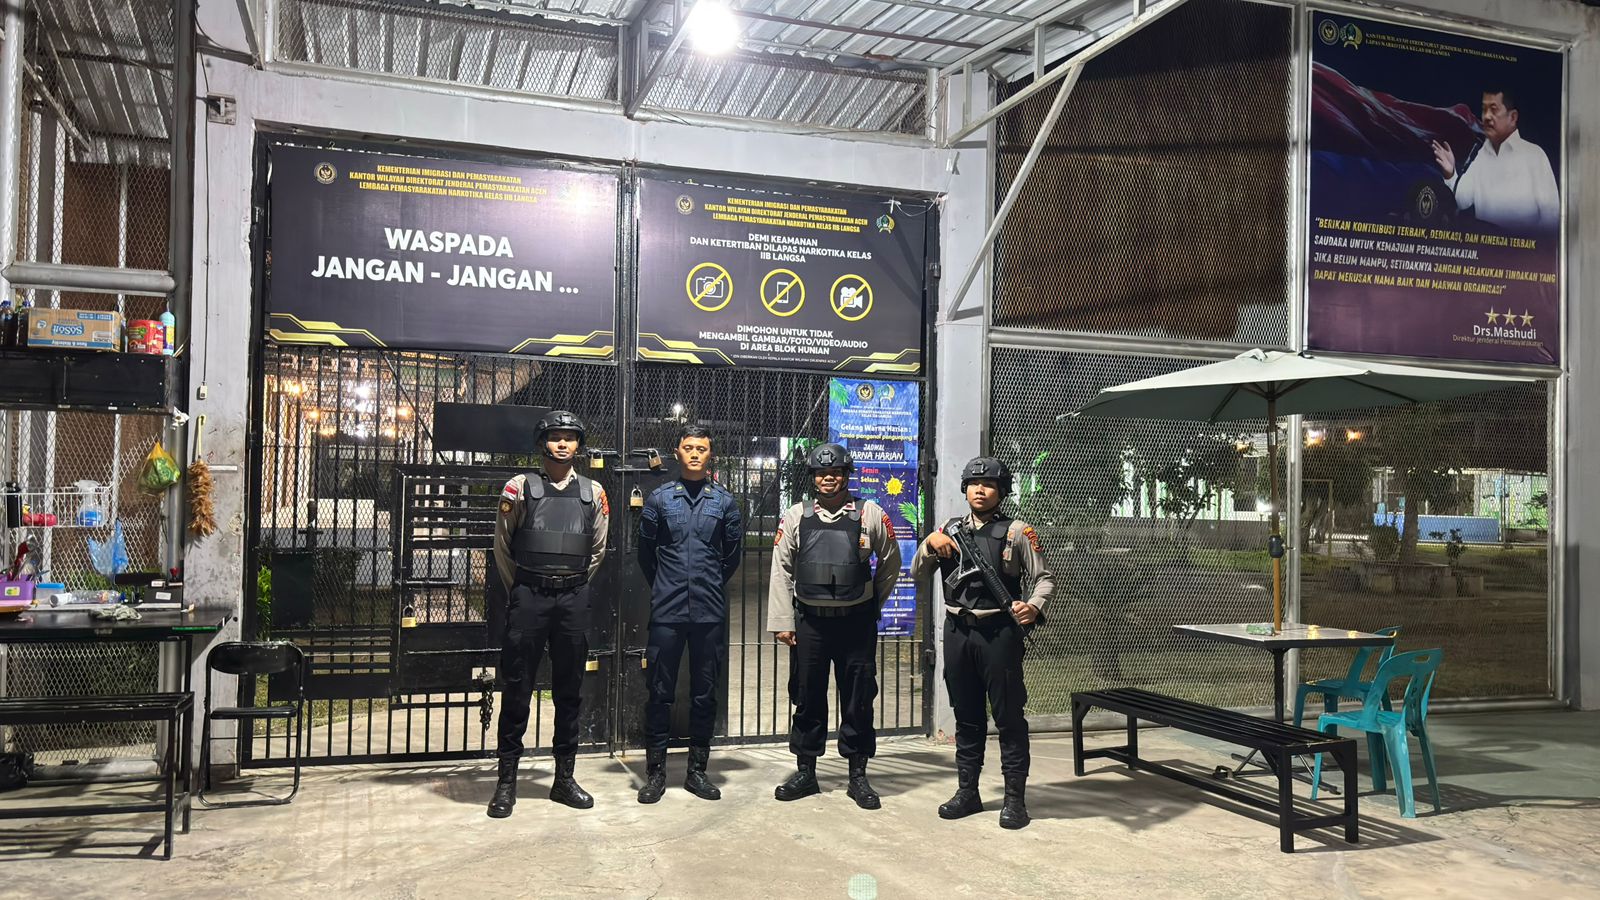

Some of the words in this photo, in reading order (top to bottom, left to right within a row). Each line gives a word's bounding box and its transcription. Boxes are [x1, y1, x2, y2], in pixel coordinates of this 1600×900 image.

[349, 172, 375, 180] KANTOR
[376, 174, 405, 182] WILAYAH
[406, 176, 444, 186] DIREKTORAT
[445, 179, 474, 188] JENDERAL
[475, 182, 529, 193] PEMASYARAKATAN
[530, 187, 547, 195] ACEH
[377, 165, 420, 175] KEMENTERIAN
[422, 169, 451, 178] IMIGRASI
[452, 171, 465, 179] DAN
[466, 172, 521, 184] PEMASYARAKATAN
[359, 181, 390, 191] LEMBAGA
[390, 184, 447, 195] PEMASYARAKATAN
[448, 189, 483, 198] NARKOTIKA
[484, 192, 503, 200] KELAS
[514, 195, 538, 203] LANGSA
[704, 203, 726, 212] KANTOR
[727, 205, 750, 214] WILAYAH
[751, 208, 783, 217] DIREKTORAT
[783, 211, 808, 220] JENDERAL
[808, 214, 854, 224] PEMASYARAKATAN
[854, 218, 868, 226] ACEH
[727, 197, 763, 207] KEMENTERIAN
[764, 201, 789, 209] IMIGRASI
[789, 203, 800, 211] DAN
[801, 204, 847, 215] PEMASYARAKATAN
[713, 213, 737, 221] LEMBAGA
[738, 215, 785, 226] PEMASYARAKATAN
[786, 219, 815, 228] NARKOTIKA
[816, 222, 831, 230] KELAS
[840, 225, 860, 233] LANGSA
[384, 227, 514, 258] WASPADA
[748, 233, 769, 242] DEMI
[771, 235, 818, 246] KEAMANAN
[1353, 222, 1395, 235] KONTRIBUSI
[1397, 225, 1427, 239] TERBAIK,
[1430, 229, 1463, 243] DEDIKASI,
[1464, 233, 1479, 243] DAN
[1480, 235, 1508, 246] KINERJA
[1509, 237, 1537, 249] TERBAIK
[690, 236, 709, 246] DAN
[710, 238, 761, 250] KETERTIBAN
[763, 243, 798, 253] DILAPAS
[799, 246, 845, 258] NARKOTIKA
[846, 250, 872, 260] KELAS
[1314, 235, 1347, 248] SAUDARA
[1349, 238, 1375, 250] UNTUK
[1376, 240, 1415, 254] KEMAJUAN
[1416, 244, 1479, 260] PEMASYARAKATAN.
[760, 252, 771, 260] IIB
[772, 253, 806, 263] LANGSA
[311, 255, 424, 284] JANGAN
[446, 264, 553, 292] JANGAN
[1313, 252, 1332, 263] JIKA
[1333, 254, 1358, 266] BELUM
[1359, 256, 1389, 270] MAMPU,
[1390, 259, 1432, 272] SETIDAKNYA
[1433, 263, 1462, 275] JANGAN
[1463, 265, 1504, 279] MELAKUKAN
[1505, 269, 1538, 282] TINDAKAN
[1539, 272, 1556, 283] YANG
[1314, 269, 1337, 281] DAPAT
[1338, 271, 1373, 284] MERUSAK
[1374, 274, 1395, 286] NAMA
[1396, 276, 1414, 288] BAIK
[1415, 278, 1431, 289] DAN
[699, 331, 750, 342] MENGAMBIL
[751, 334, 868, 349] GAMBAR/FOTO/VIDEO/AUDIO
[737, 325, 778, 335] DIMOHON
[780, 327, 808, 336] UNTUK
[809, 329, 834, 338] TIDAK
[1452, 334, 1476, 343] Direktur
[1476, 337, 1499, 345] Jenderal
[1500, 338, 1543, 347] Pemasyarakatan
[1473, 324, 1537, 340] Drs.Mashudi
[740, 343, 749, 351] DI
[750, 343, 773, 352] AREA
[774, 345, 797, 353] BLOK
[797, 346, 830, 355] HUNIAN
[840, 423, 863, 432] Gelang
[864, 424, 887, 432] Warna
[863, 443, 885, 451] JADWAL
[875, 451, 903, 460] HARIAN
[861, 466, 879, 474] Senin
